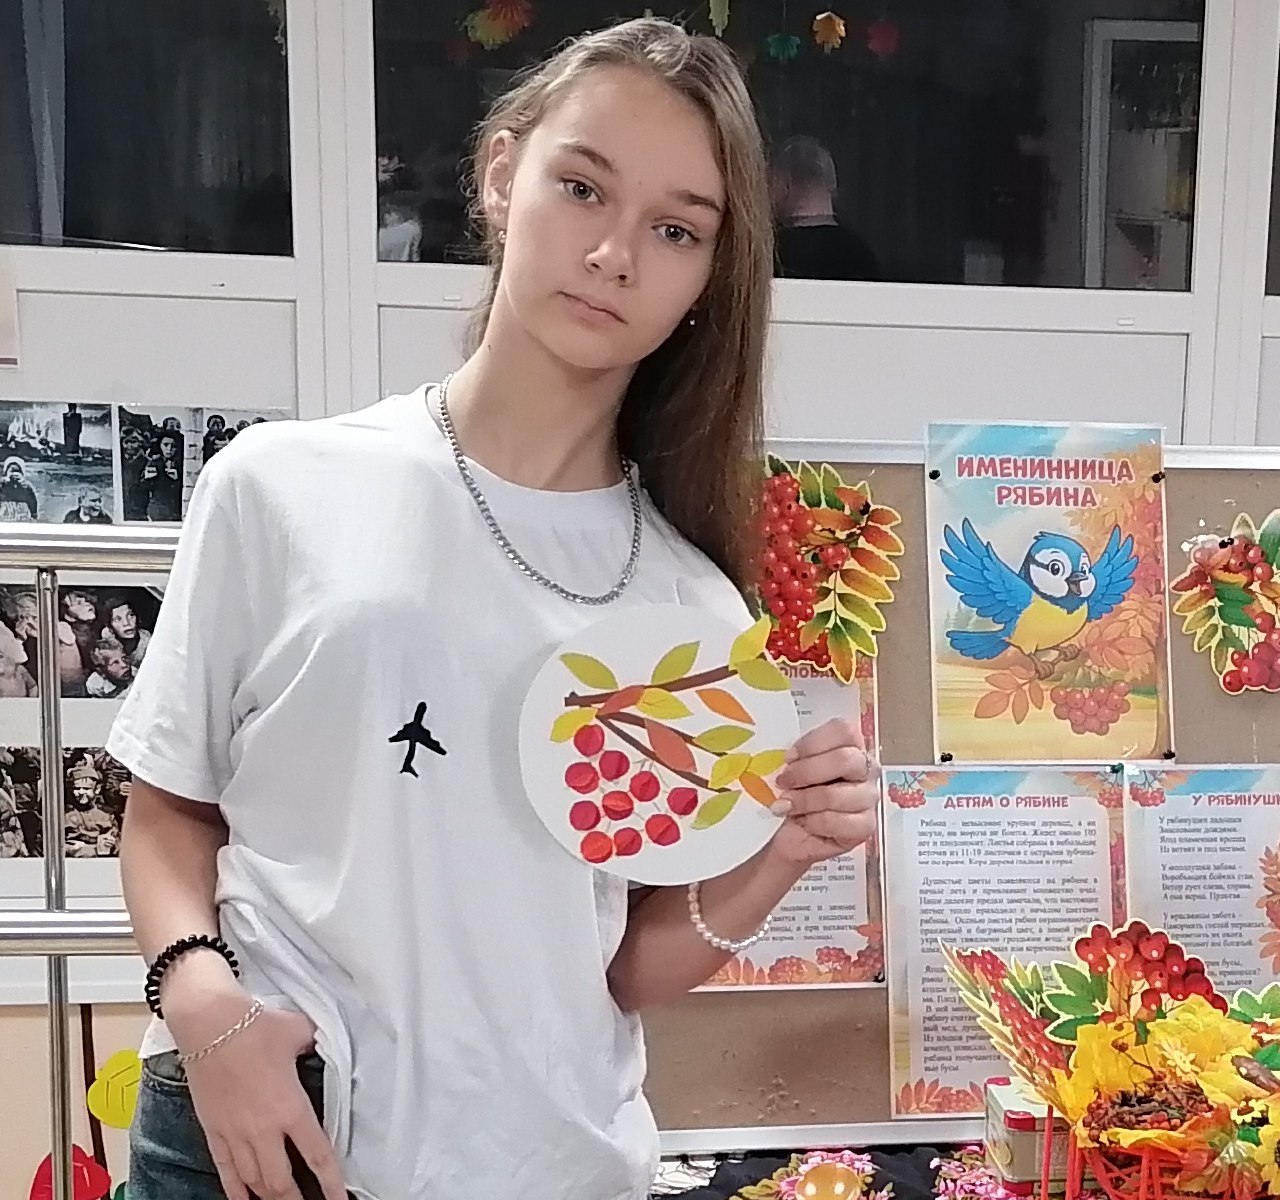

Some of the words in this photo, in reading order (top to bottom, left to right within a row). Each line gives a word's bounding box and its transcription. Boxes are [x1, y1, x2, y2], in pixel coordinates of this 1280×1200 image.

[958, 456, 1134, 484] ИМЕНИННИЦА
[997, 486, 1097, 507] РЯБИНА
[944, 796, 994, 809] ДЕТЯМ
[999, 797, 1010, 808] О
[1016, 796, 1069, 808] РЯБИНЕ
[1192, 795, 1202, 806] У
